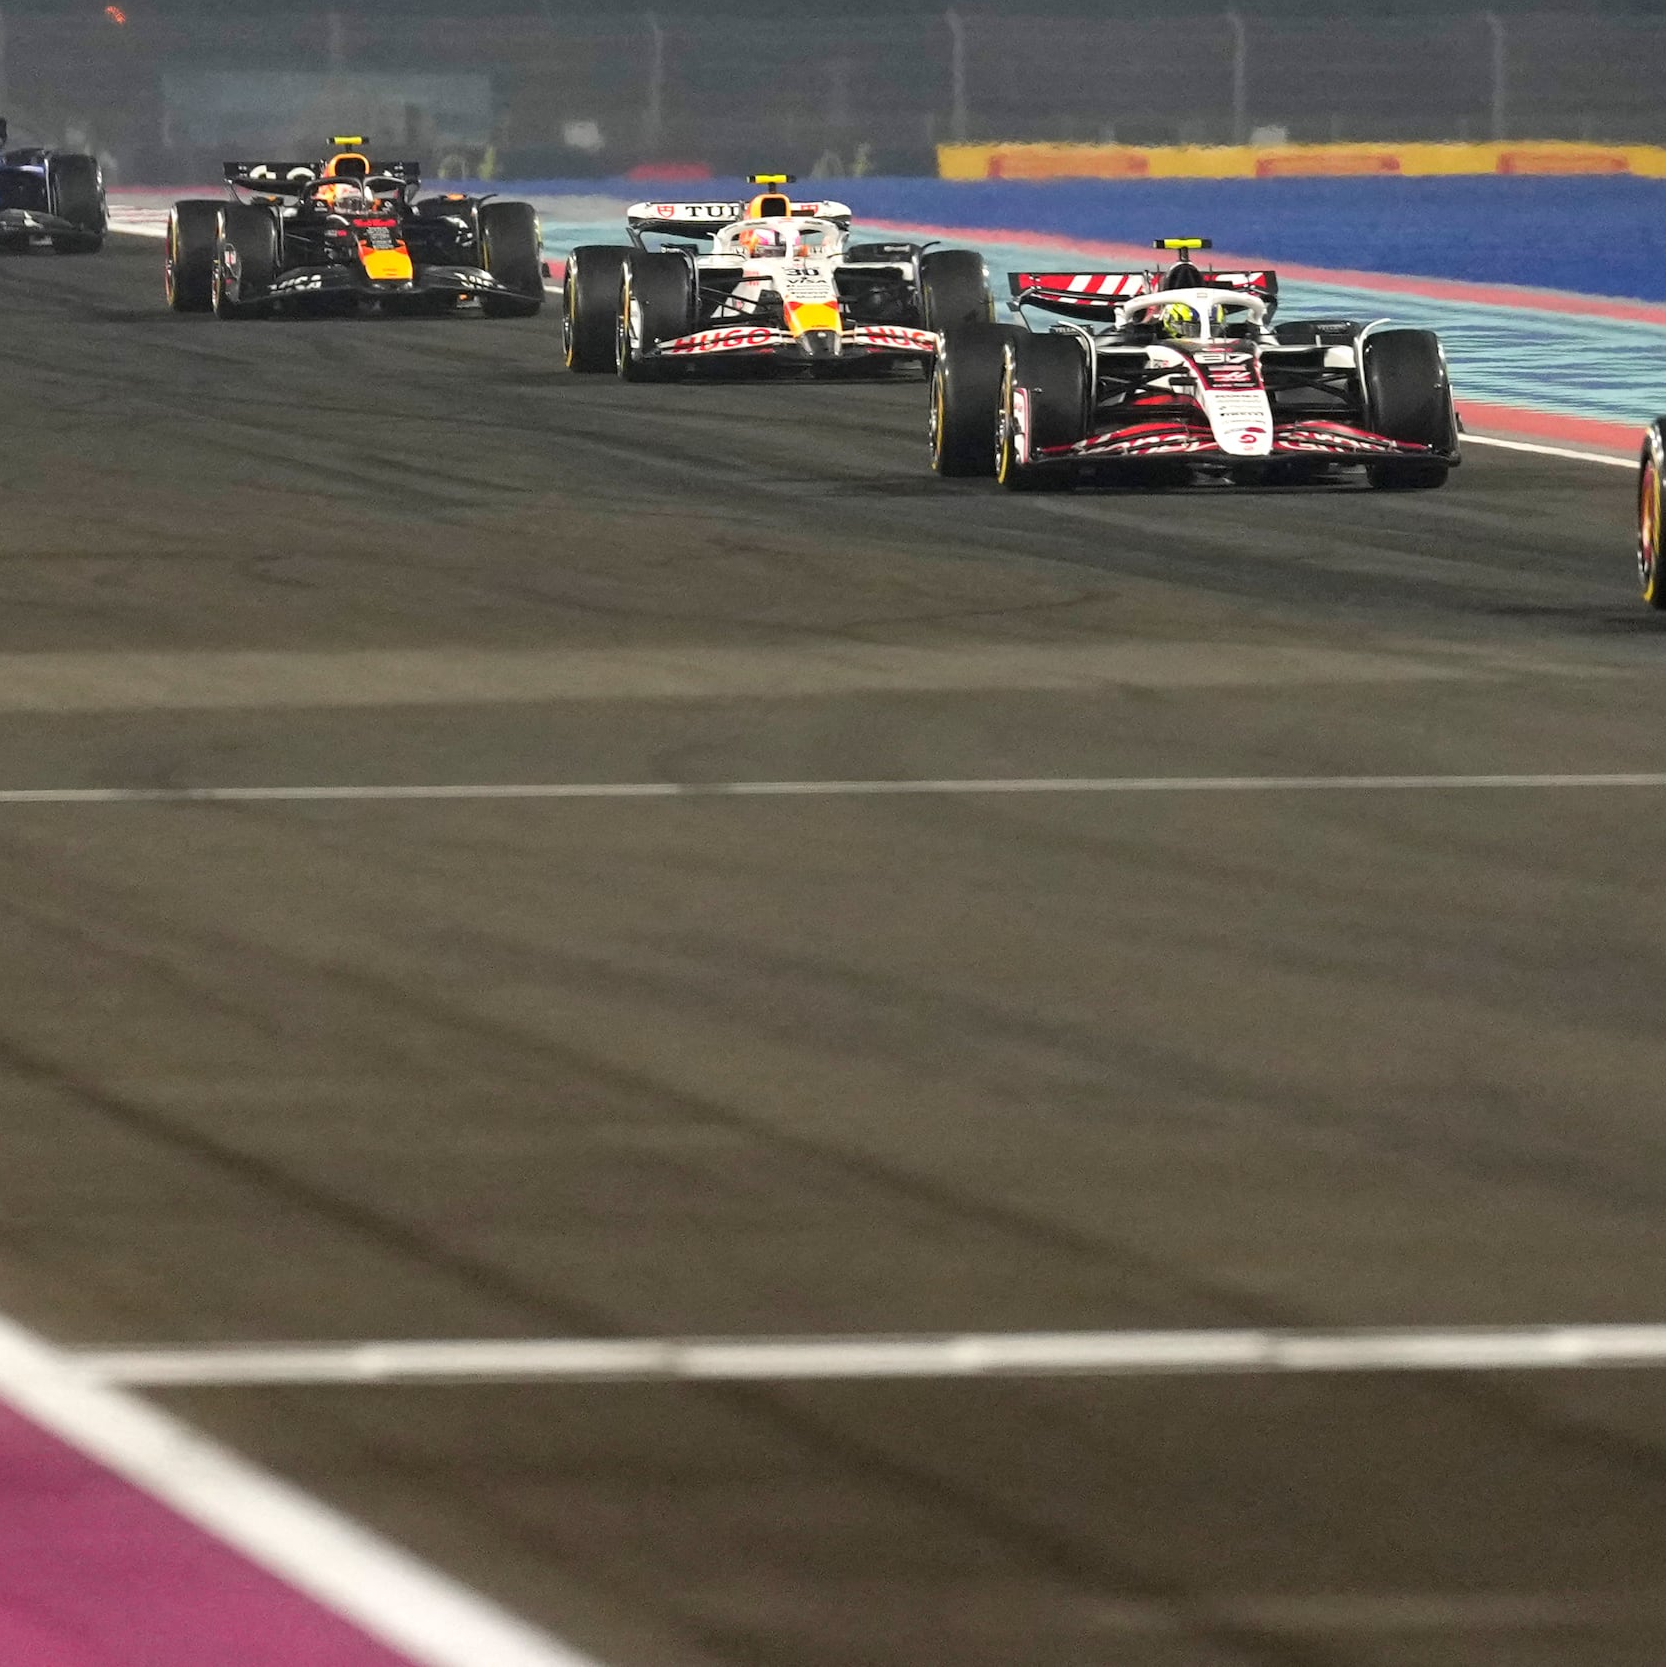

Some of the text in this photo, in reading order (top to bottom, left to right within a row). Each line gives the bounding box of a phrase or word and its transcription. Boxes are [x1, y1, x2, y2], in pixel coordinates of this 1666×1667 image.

[783, 268, 820, 276] 30
[672, 328, 771, 353] HUGO
[1193, 352, 1253, 365] 87
